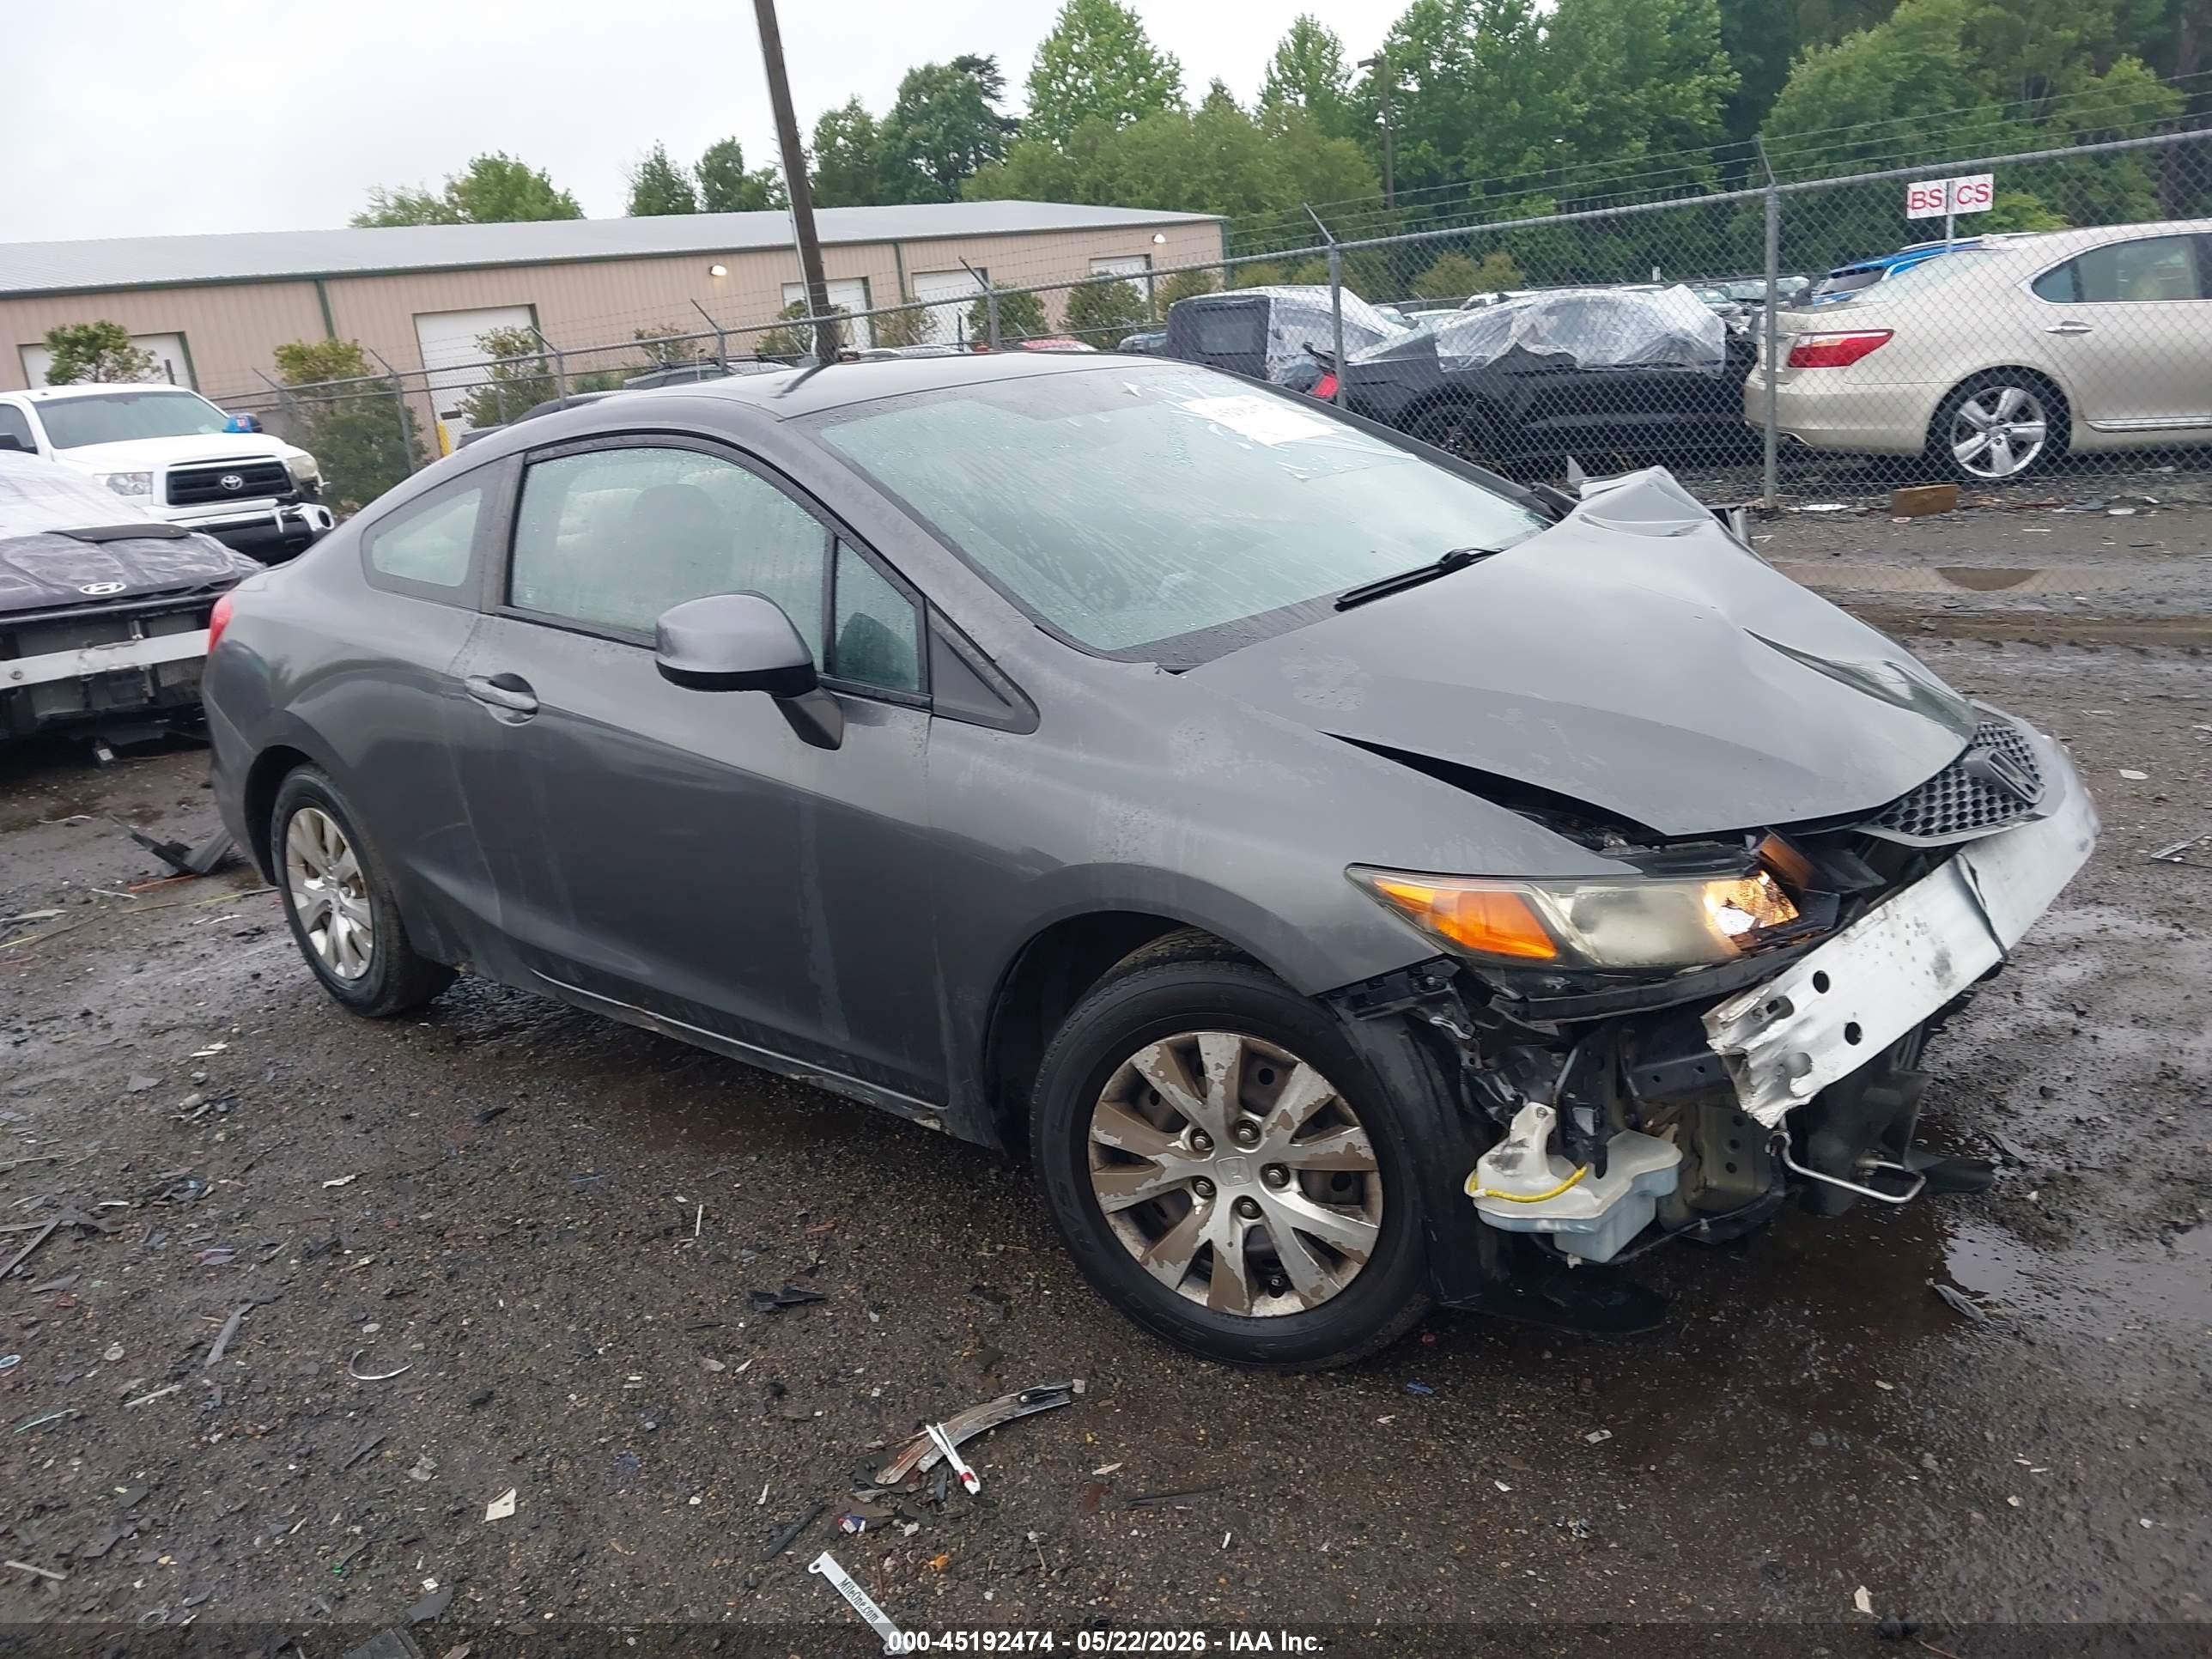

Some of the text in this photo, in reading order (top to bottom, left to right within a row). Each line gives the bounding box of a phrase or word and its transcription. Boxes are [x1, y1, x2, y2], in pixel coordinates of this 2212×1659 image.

[1911, 188, 1943, 210] BS
[1956, 183, 1990, 205] CS
[837, 1577, 879, 1623] MileOne.com
